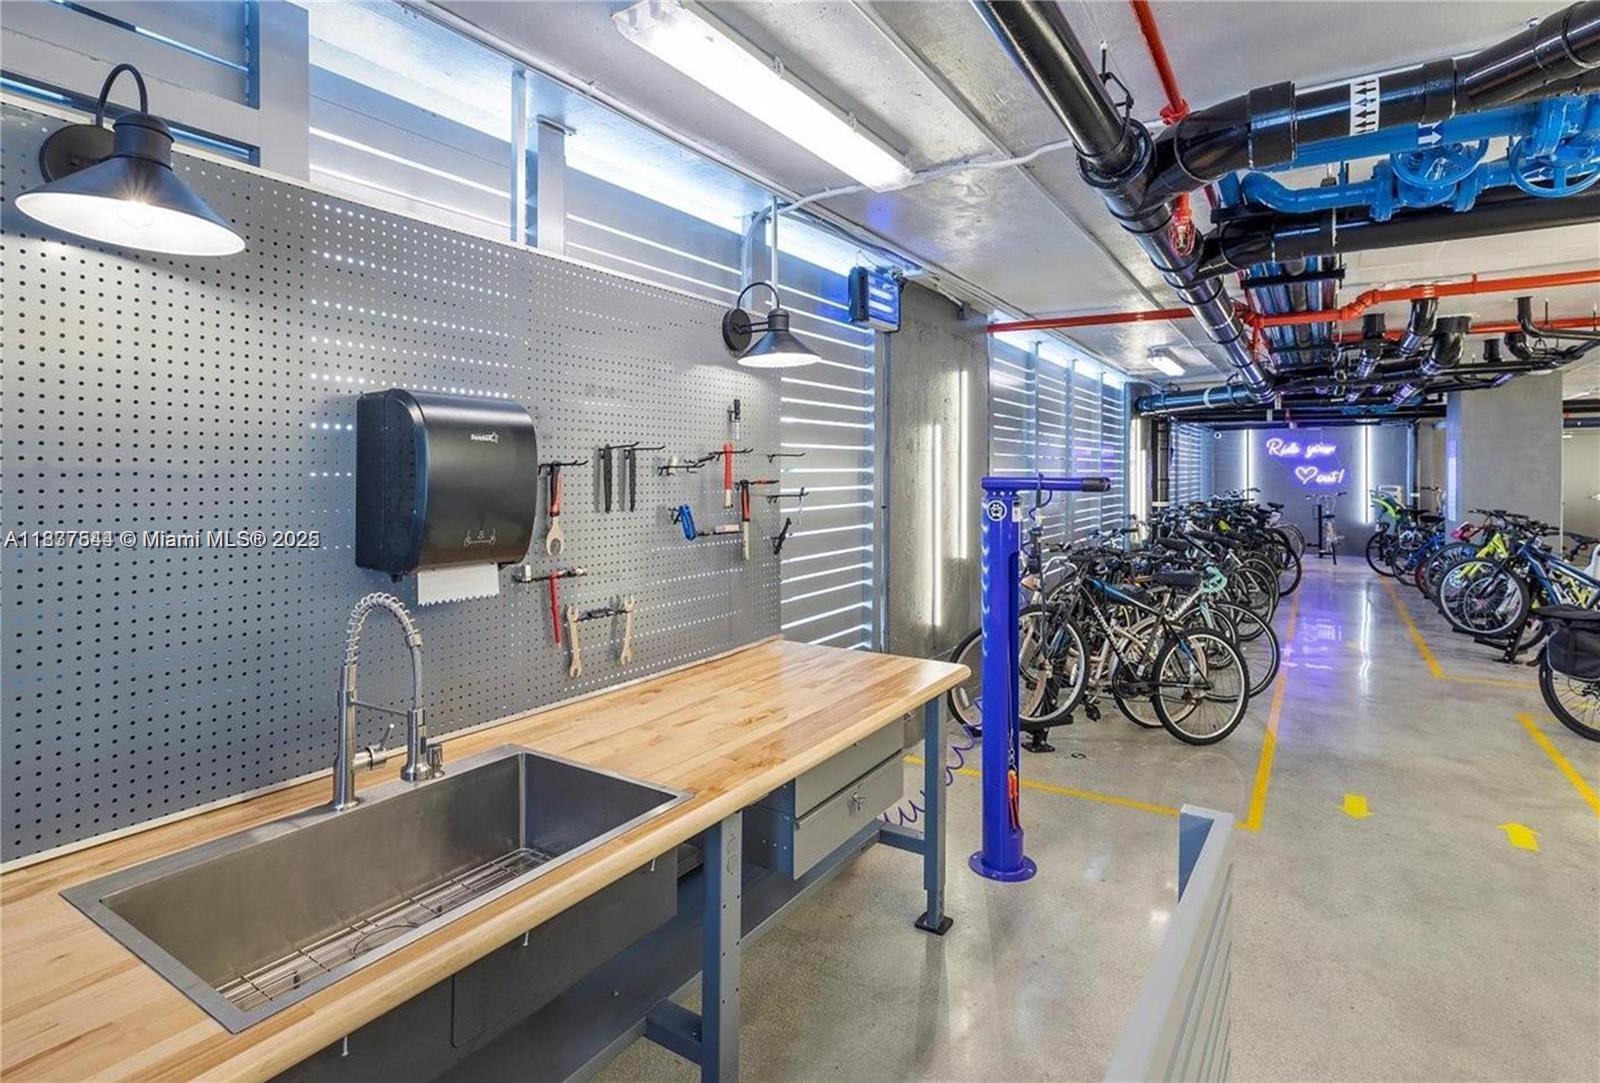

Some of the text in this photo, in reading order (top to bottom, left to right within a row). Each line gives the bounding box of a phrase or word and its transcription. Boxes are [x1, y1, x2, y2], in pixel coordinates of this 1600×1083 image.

[1266, 438, 1337, 459] Ride your
[1316, 469, 1345, 484] out!
